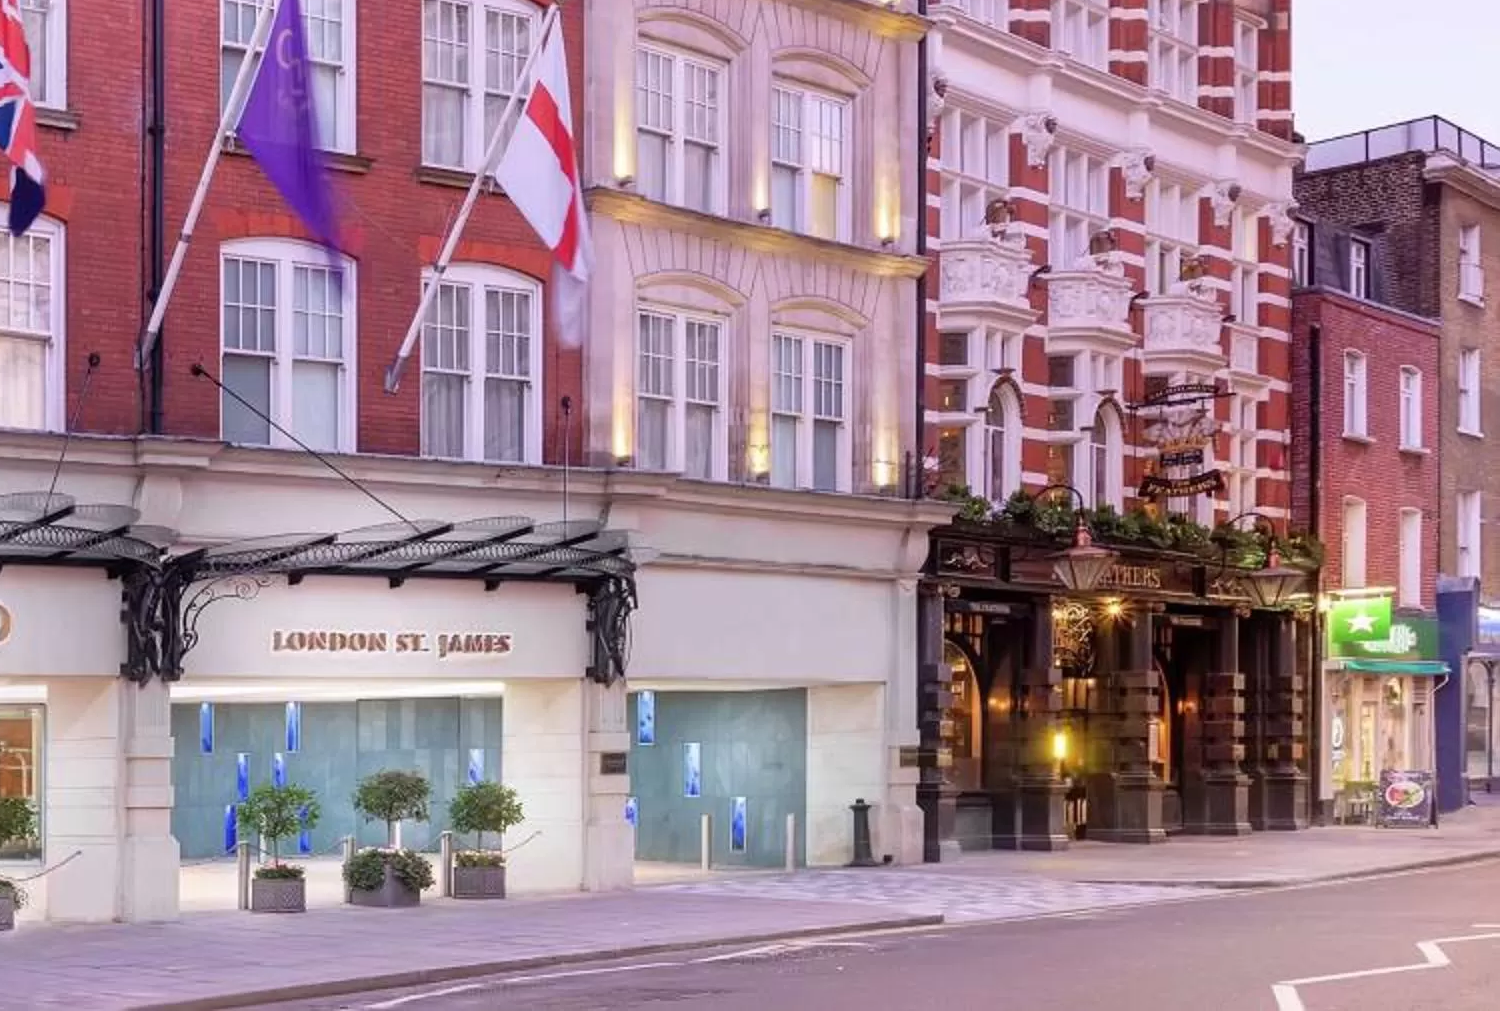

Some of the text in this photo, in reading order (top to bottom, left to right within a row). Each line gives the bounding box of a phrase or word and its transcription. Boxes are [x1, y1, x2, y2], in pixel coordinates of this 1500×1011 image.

[1099, 564, 1161, 588] ATHERS
[273, 630, 512, 658] LONDON ST. JAMES
